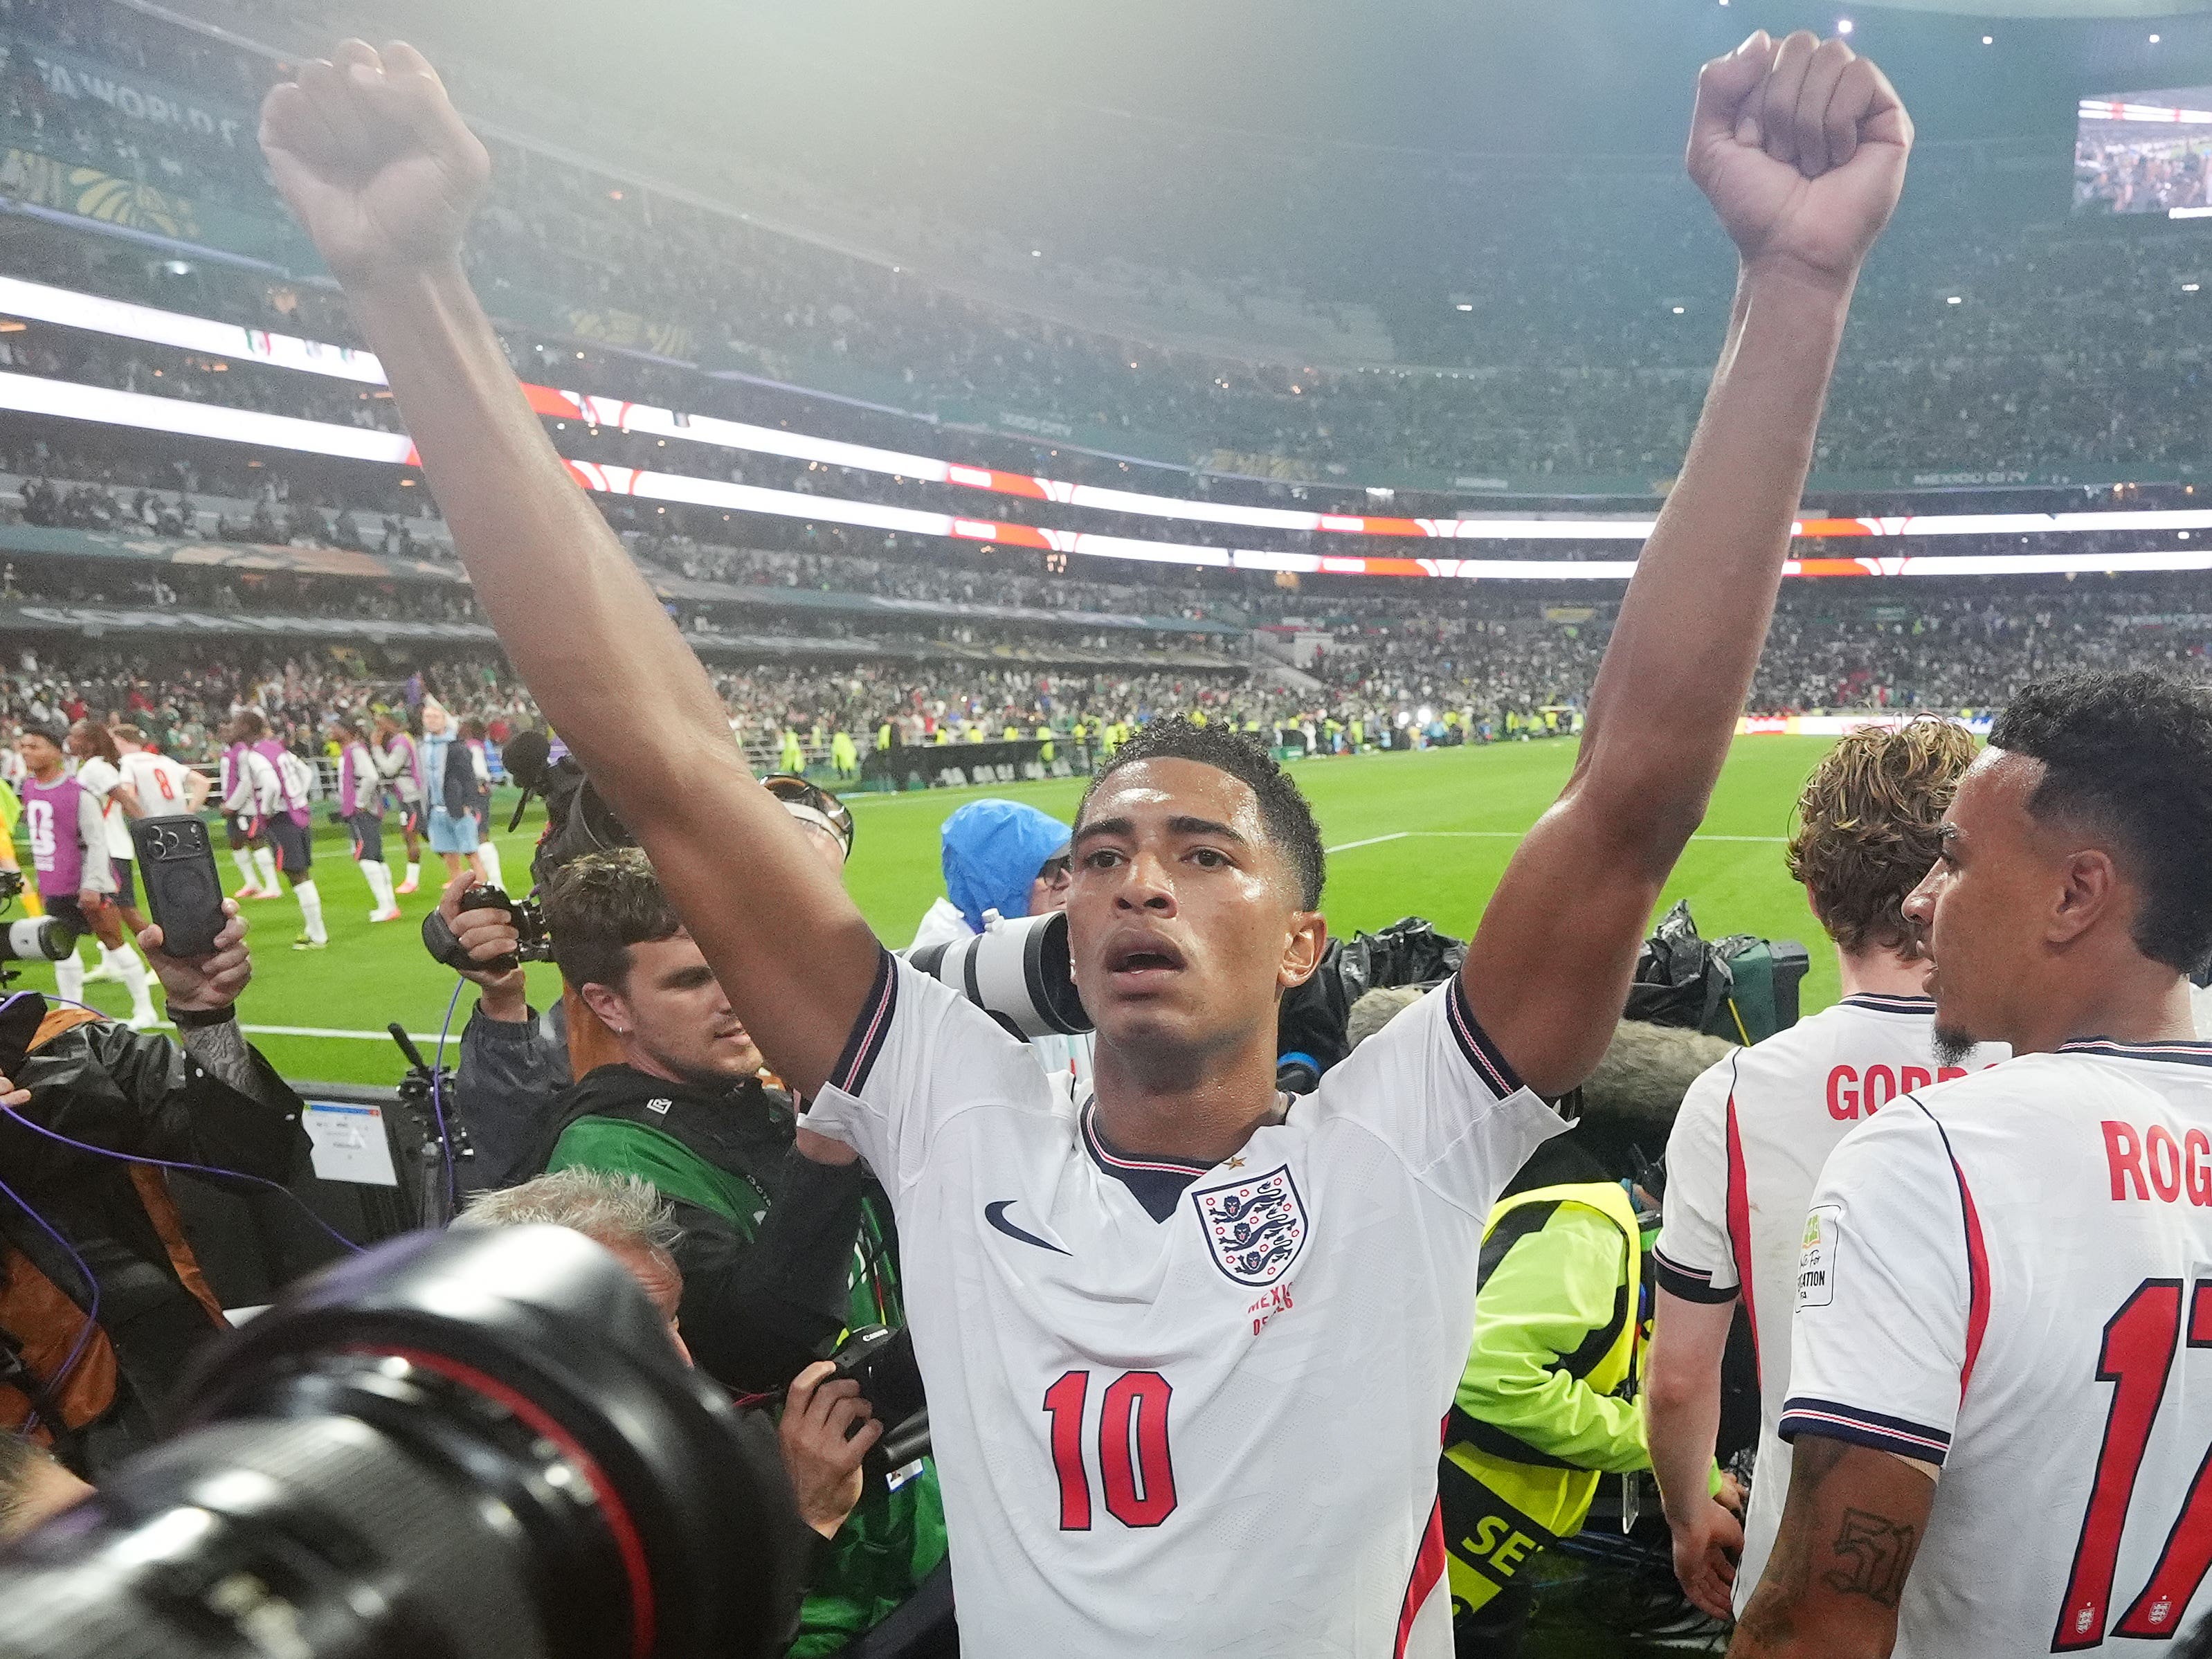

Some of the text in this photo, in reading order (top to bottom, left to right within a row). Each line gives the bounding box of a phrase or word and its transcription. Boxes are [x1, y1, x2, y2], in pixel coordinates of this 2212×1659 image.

[154, 768, 174, 800] 8
[1826, 1063, 2000, 1121] GOR
[1797, 1270, 1825, 1292] ATION
[1042, 1370, 1178, 1531] 10
[1461, 1516, 1545, 1577] SE
